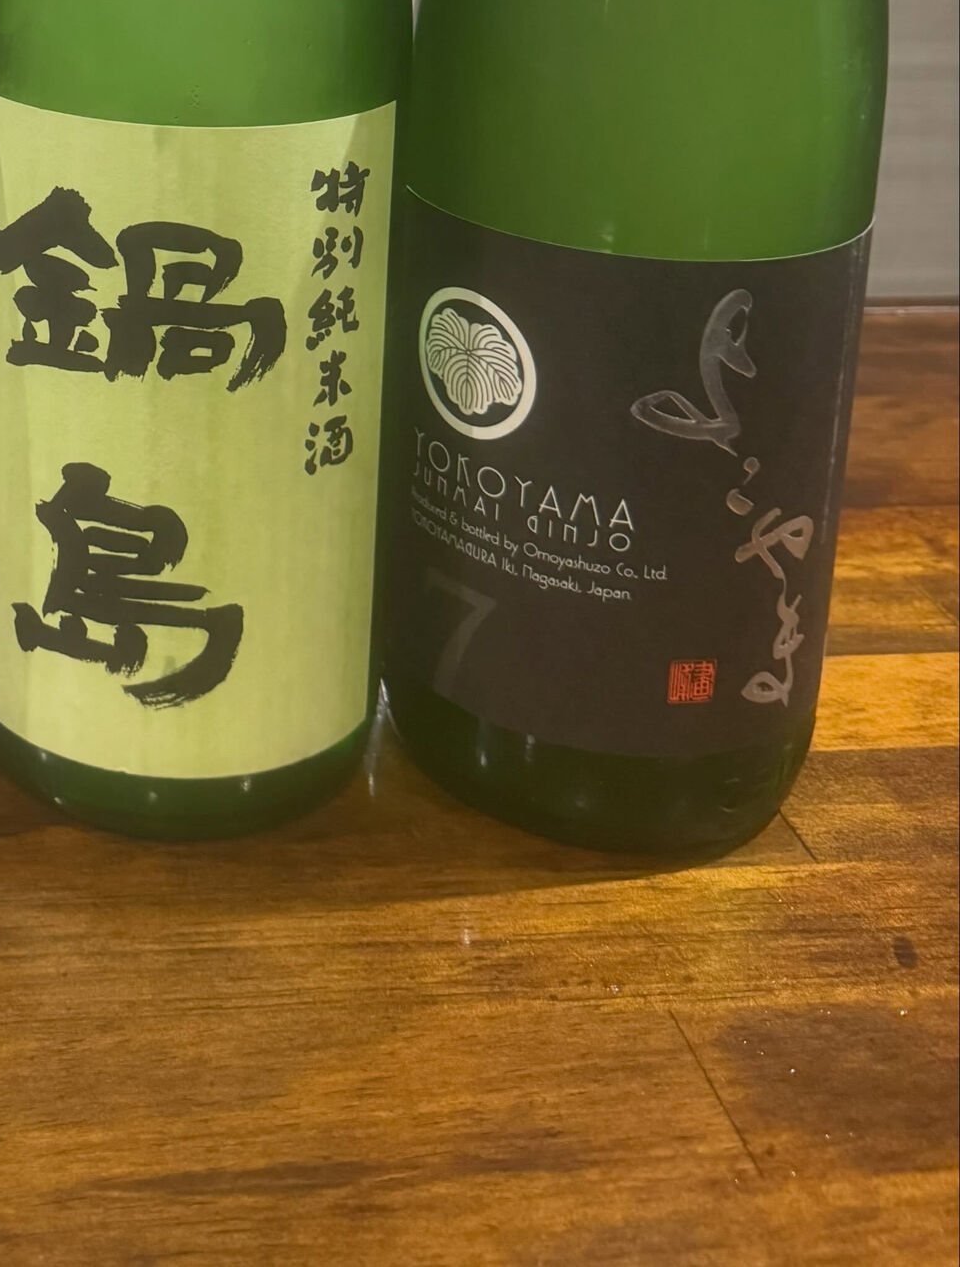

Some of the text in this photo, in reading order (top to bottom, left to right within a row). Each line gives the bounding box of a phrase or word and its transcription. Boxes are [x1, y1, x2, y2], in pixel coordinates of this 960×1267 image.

[304, 160, 371, 476] 特別純米酒
[415, 427, 634, 532] YOKOYAMA
[461, 516, 500, 546] bottled
[503, 534, 519, 557] by
[523, 542, 611, 574] Omoyashuzo
